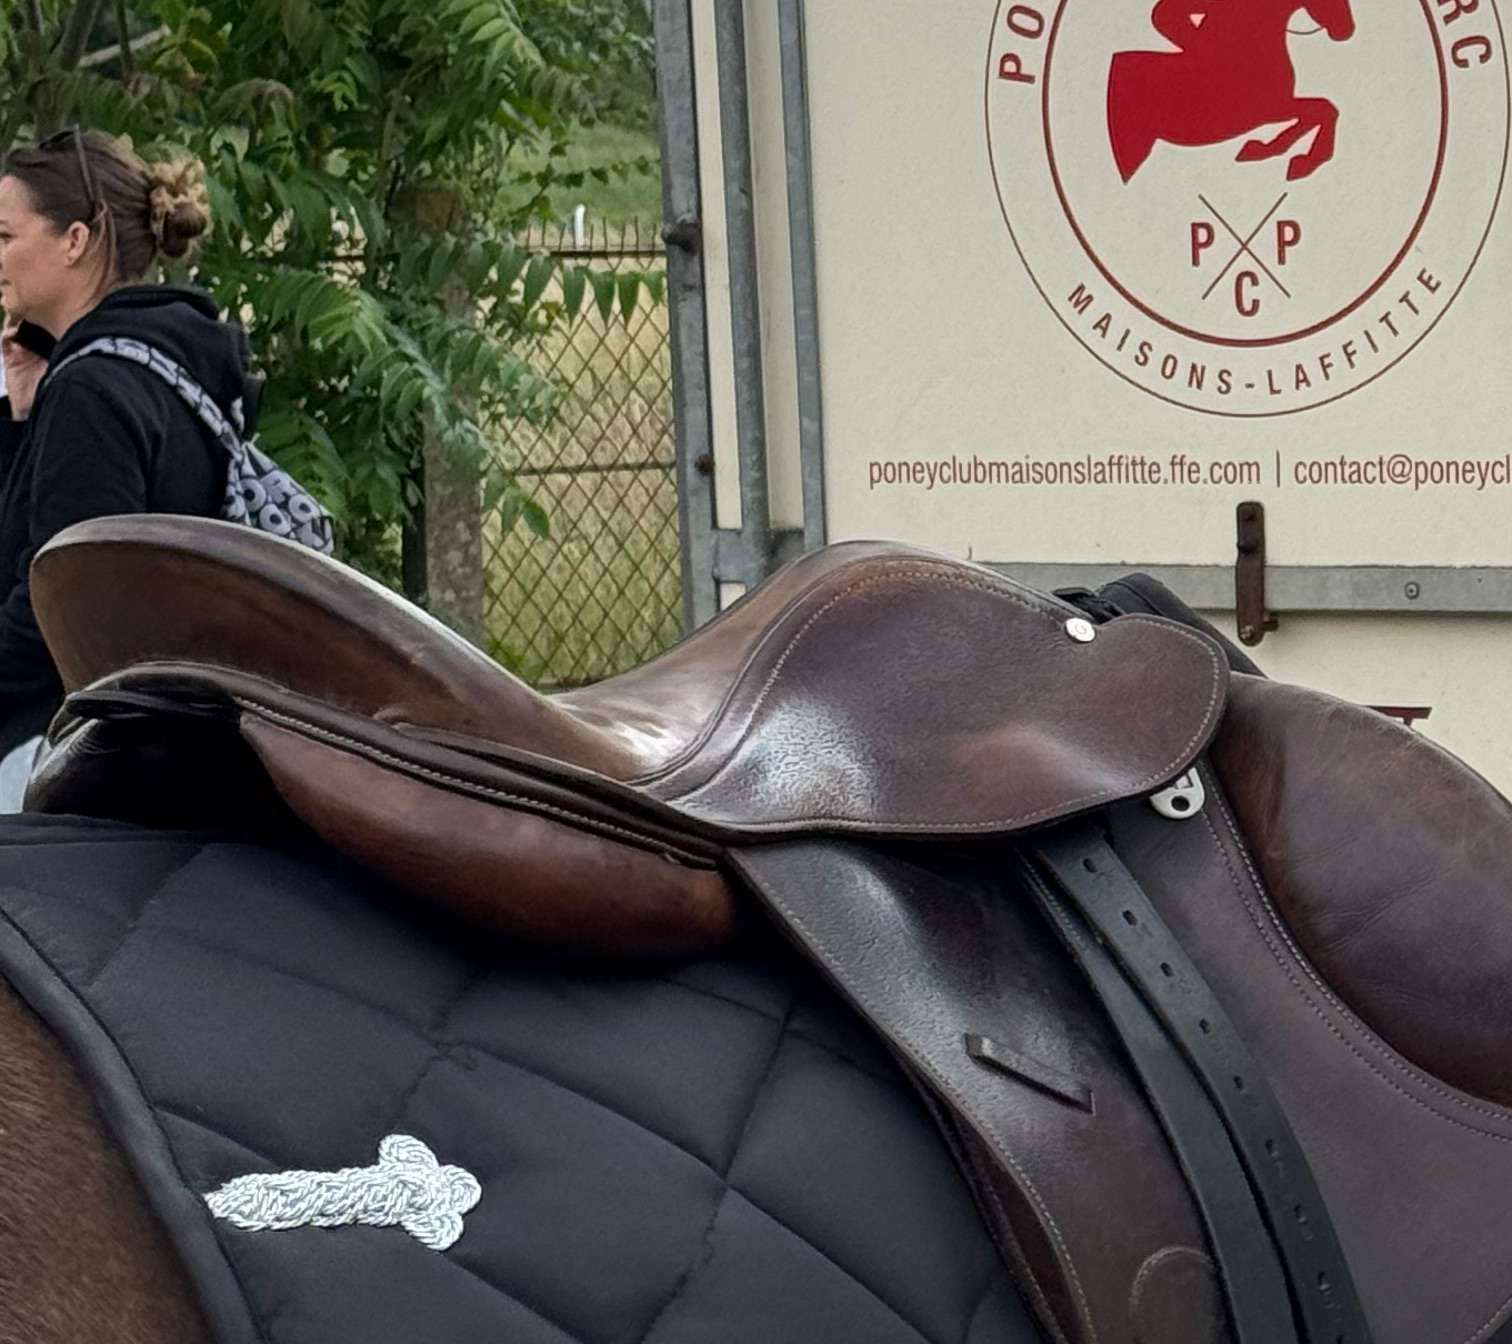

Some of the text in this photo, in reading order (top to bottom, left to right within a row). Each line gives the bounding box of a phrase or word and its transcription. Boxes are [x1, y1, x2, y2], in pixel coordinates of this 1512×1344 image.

[1190, 219, 1301, 267] P P
[1235, 270, 1260, 317] C
[1067, 267, 1442, 396] MAISONS-LAFFITTE
[869, 454, 1261, 489] poneyclubmaisonslaffitte.ffe.com
